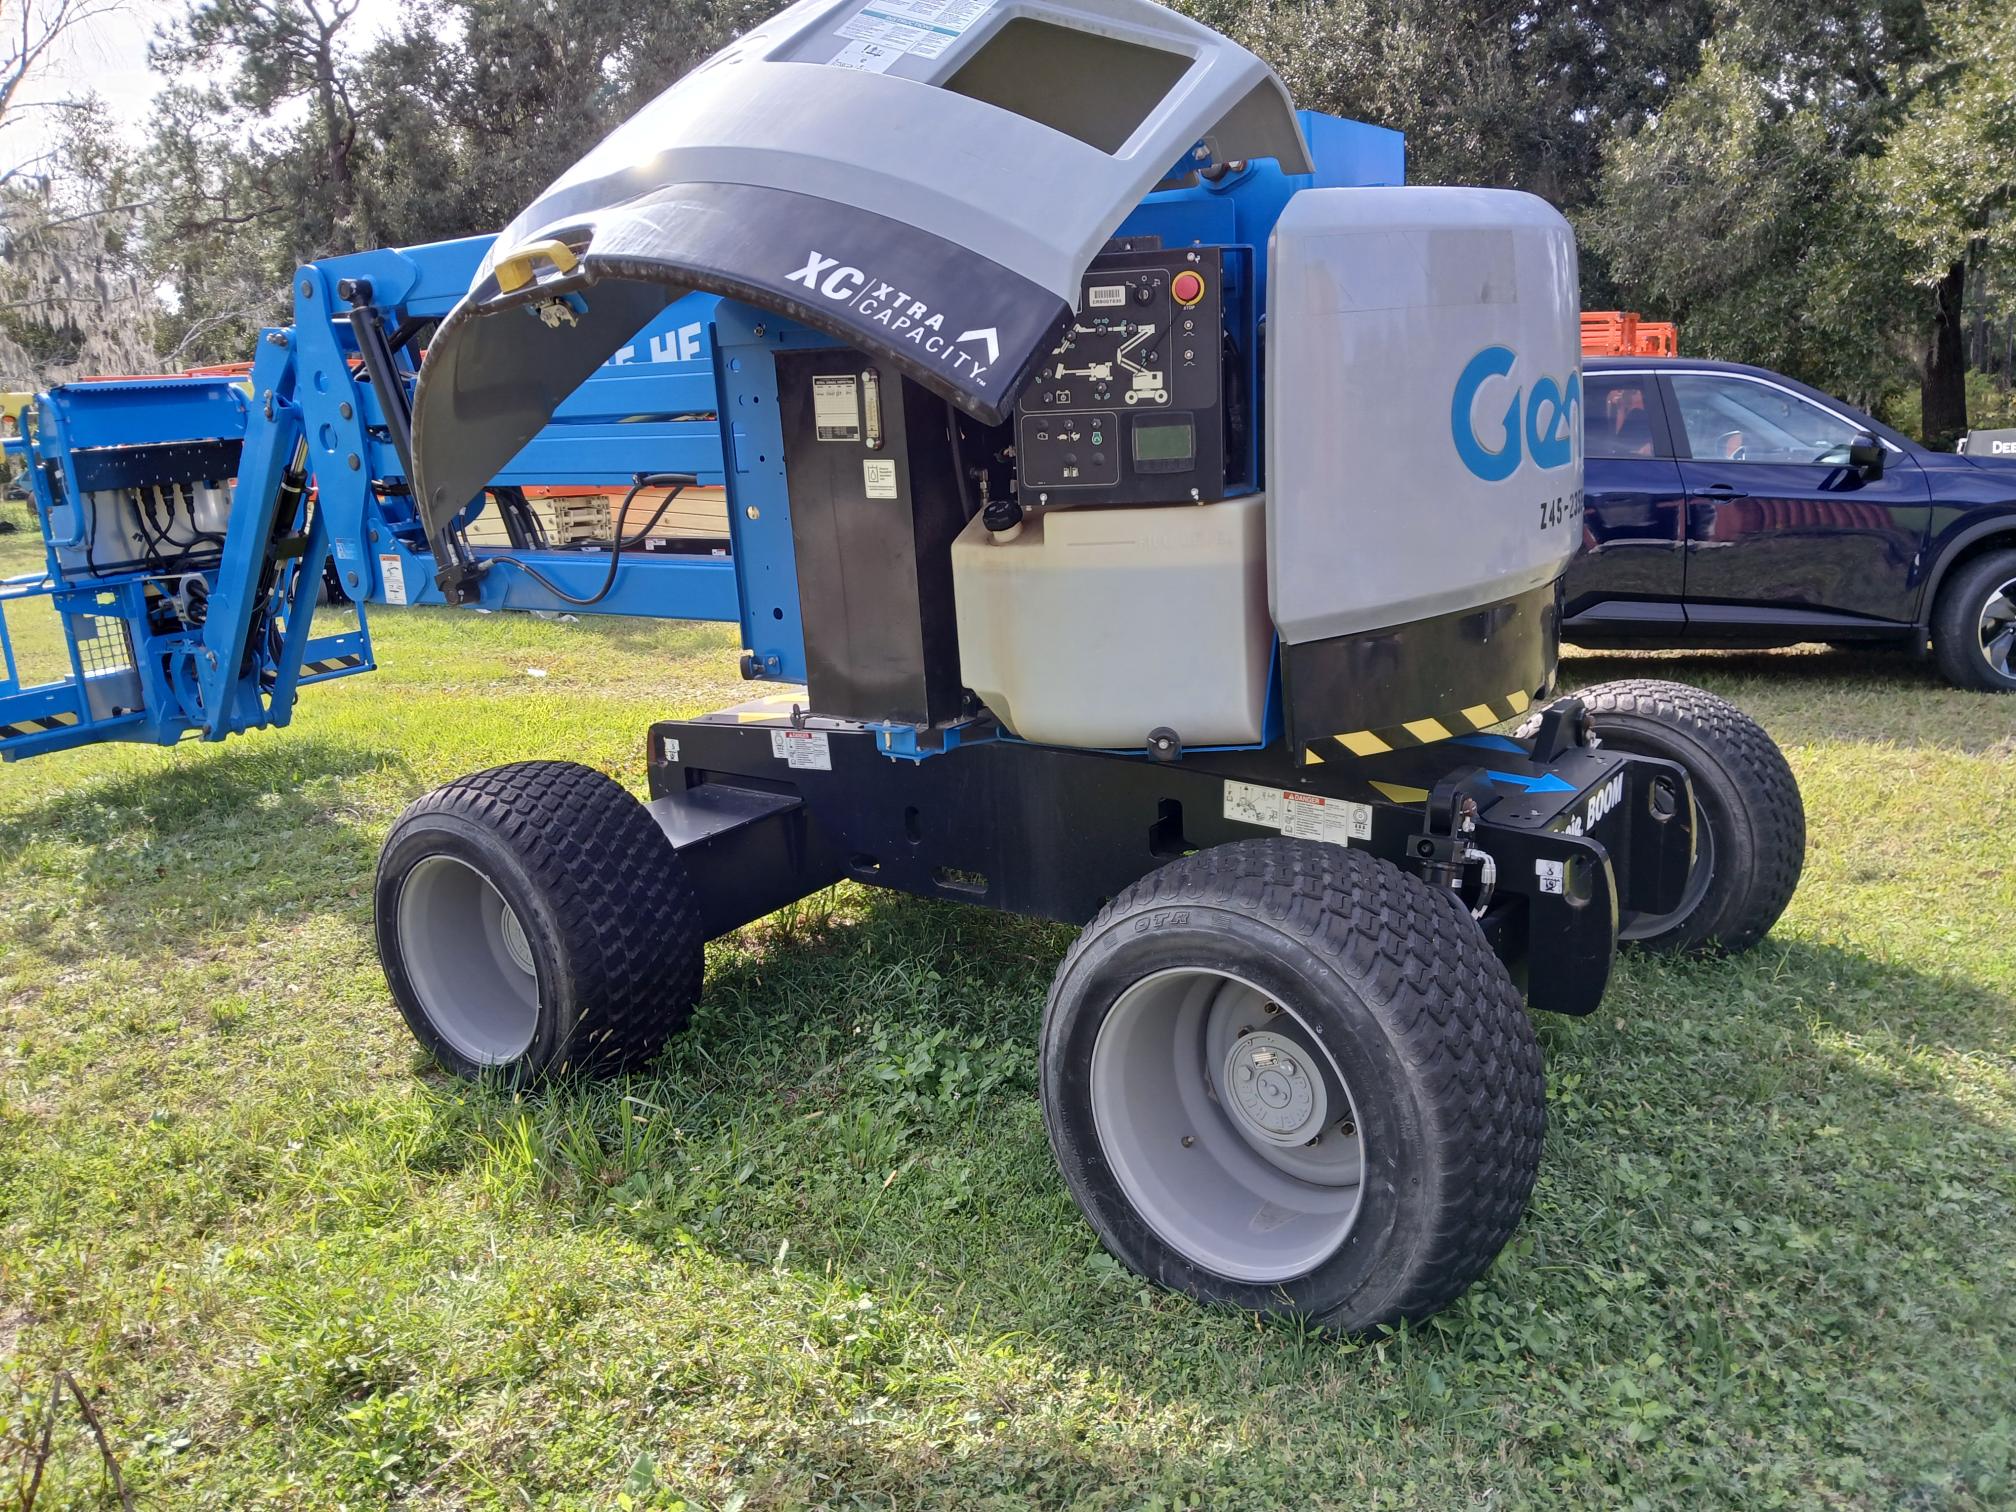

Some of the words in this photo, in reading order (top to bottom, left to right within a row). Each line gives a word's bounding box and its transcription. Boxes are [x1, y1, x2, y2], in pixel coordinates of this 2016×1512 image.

[784, 250, 865, 300] XC
[871, 282, 945, 331] XTRA
[858, 299, 987, 379] CAPACITY
[1294, 794, 1320, 805] DANGER
[1586, 771, 1624, 831] BOOM
[1134, 911, 1191, 933] OTR
